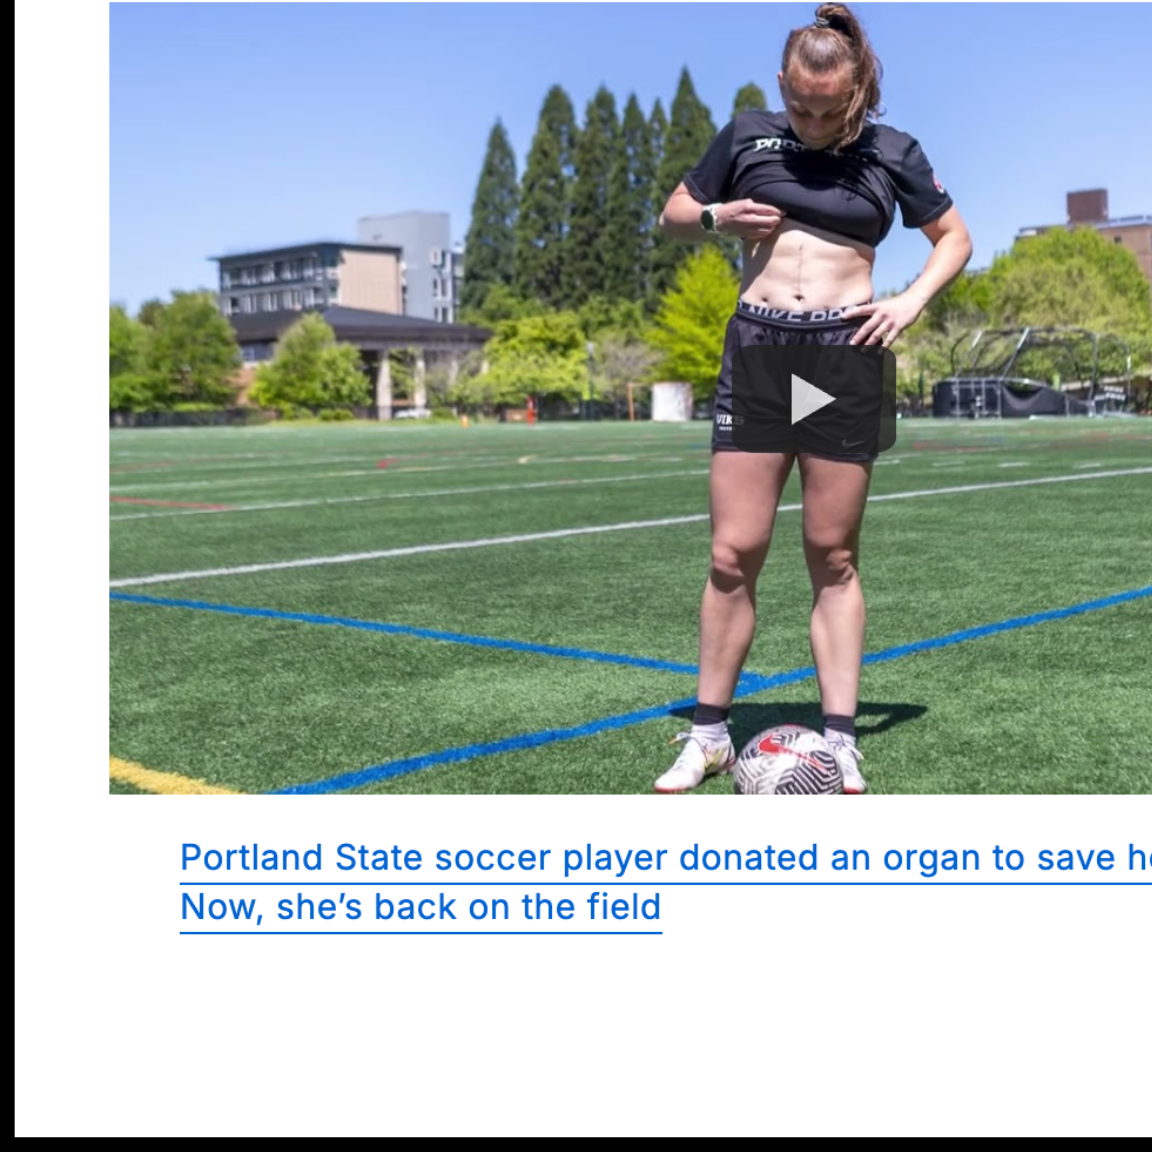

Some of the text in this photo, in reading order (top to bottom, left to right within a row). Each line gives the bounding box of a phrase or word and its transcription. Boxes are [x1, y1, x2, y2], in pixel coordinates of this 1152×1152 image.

[182, 843, 321, 871] Portland
[336, 843, 422, 871] State
[436, 849, 551, 871] soccer
[564, 843, 668, 878] player
[680, 843, 817, 871] donated
[831, 849, 870, 871] an
[884, 849, 979, 878] organ
[992, 845, 1024, 871] to
[1038, 849, 1115, 871] save
[182, 892, 660, 926] Now, she’s back on the field
